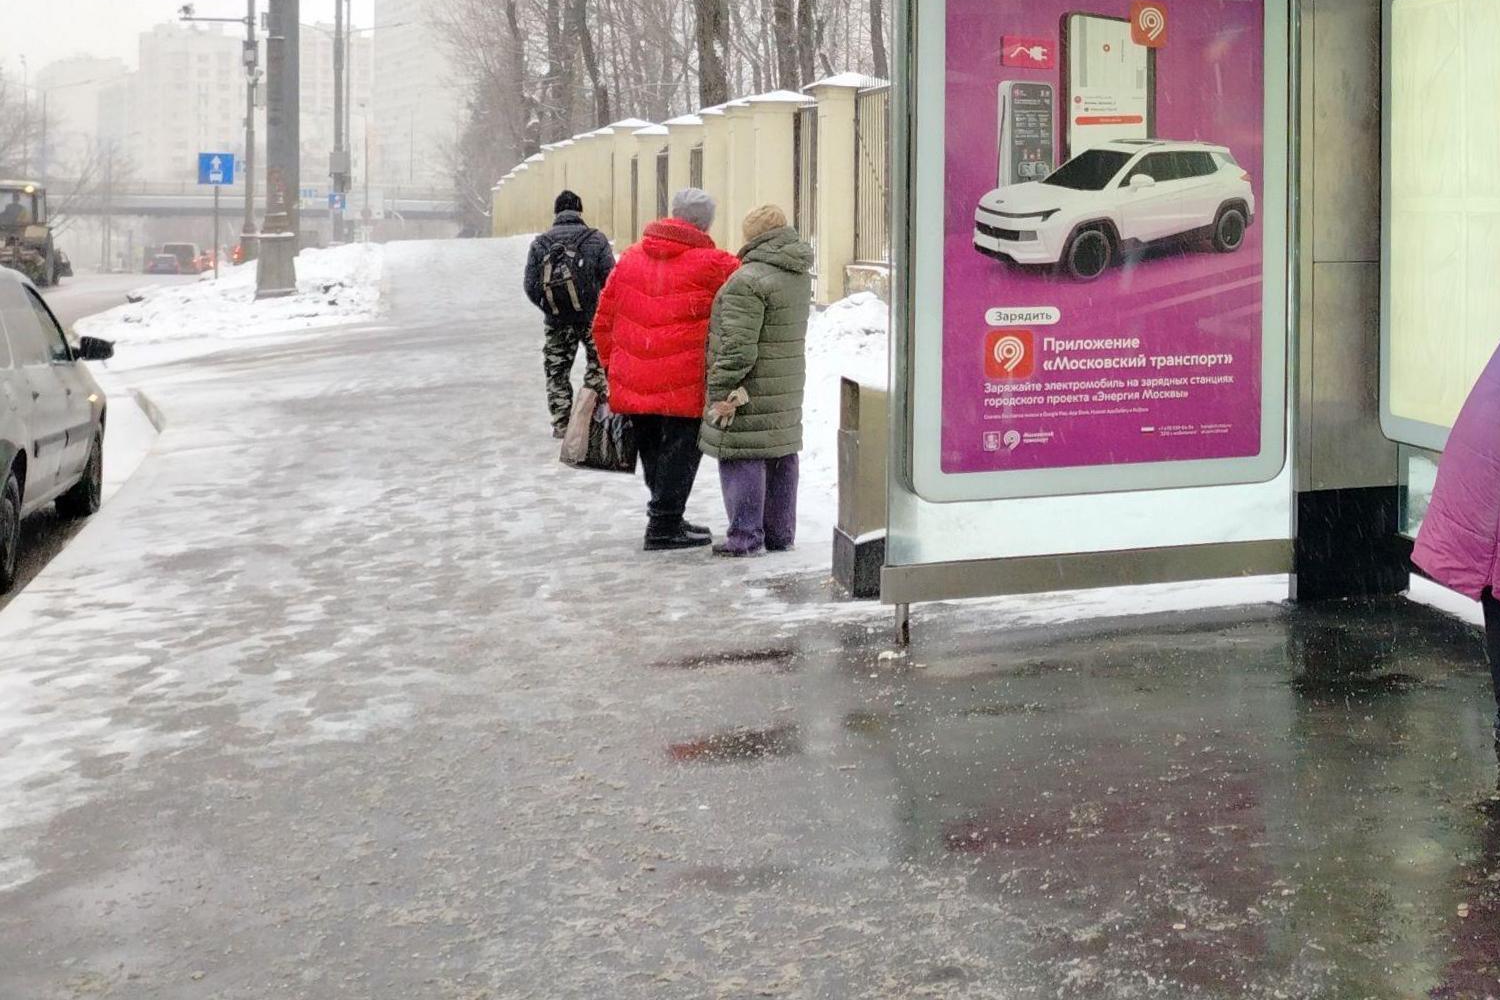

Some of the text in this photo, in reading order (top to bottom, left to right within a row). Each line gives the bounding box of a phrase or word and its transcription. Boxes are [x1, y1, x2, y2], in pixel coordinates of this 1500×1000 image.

[995, 311, 1052, 323] Зарядить
[1043, 337, 1140, 354] Приложение
[1043, 353, 1233, 371] «Московский транспорт»
[984, 375, 1234, 394] Заряжайте электромобиль на зарядных станциях
[984, 389, 1189, 408] городского проекта «Энергия Москвы»
